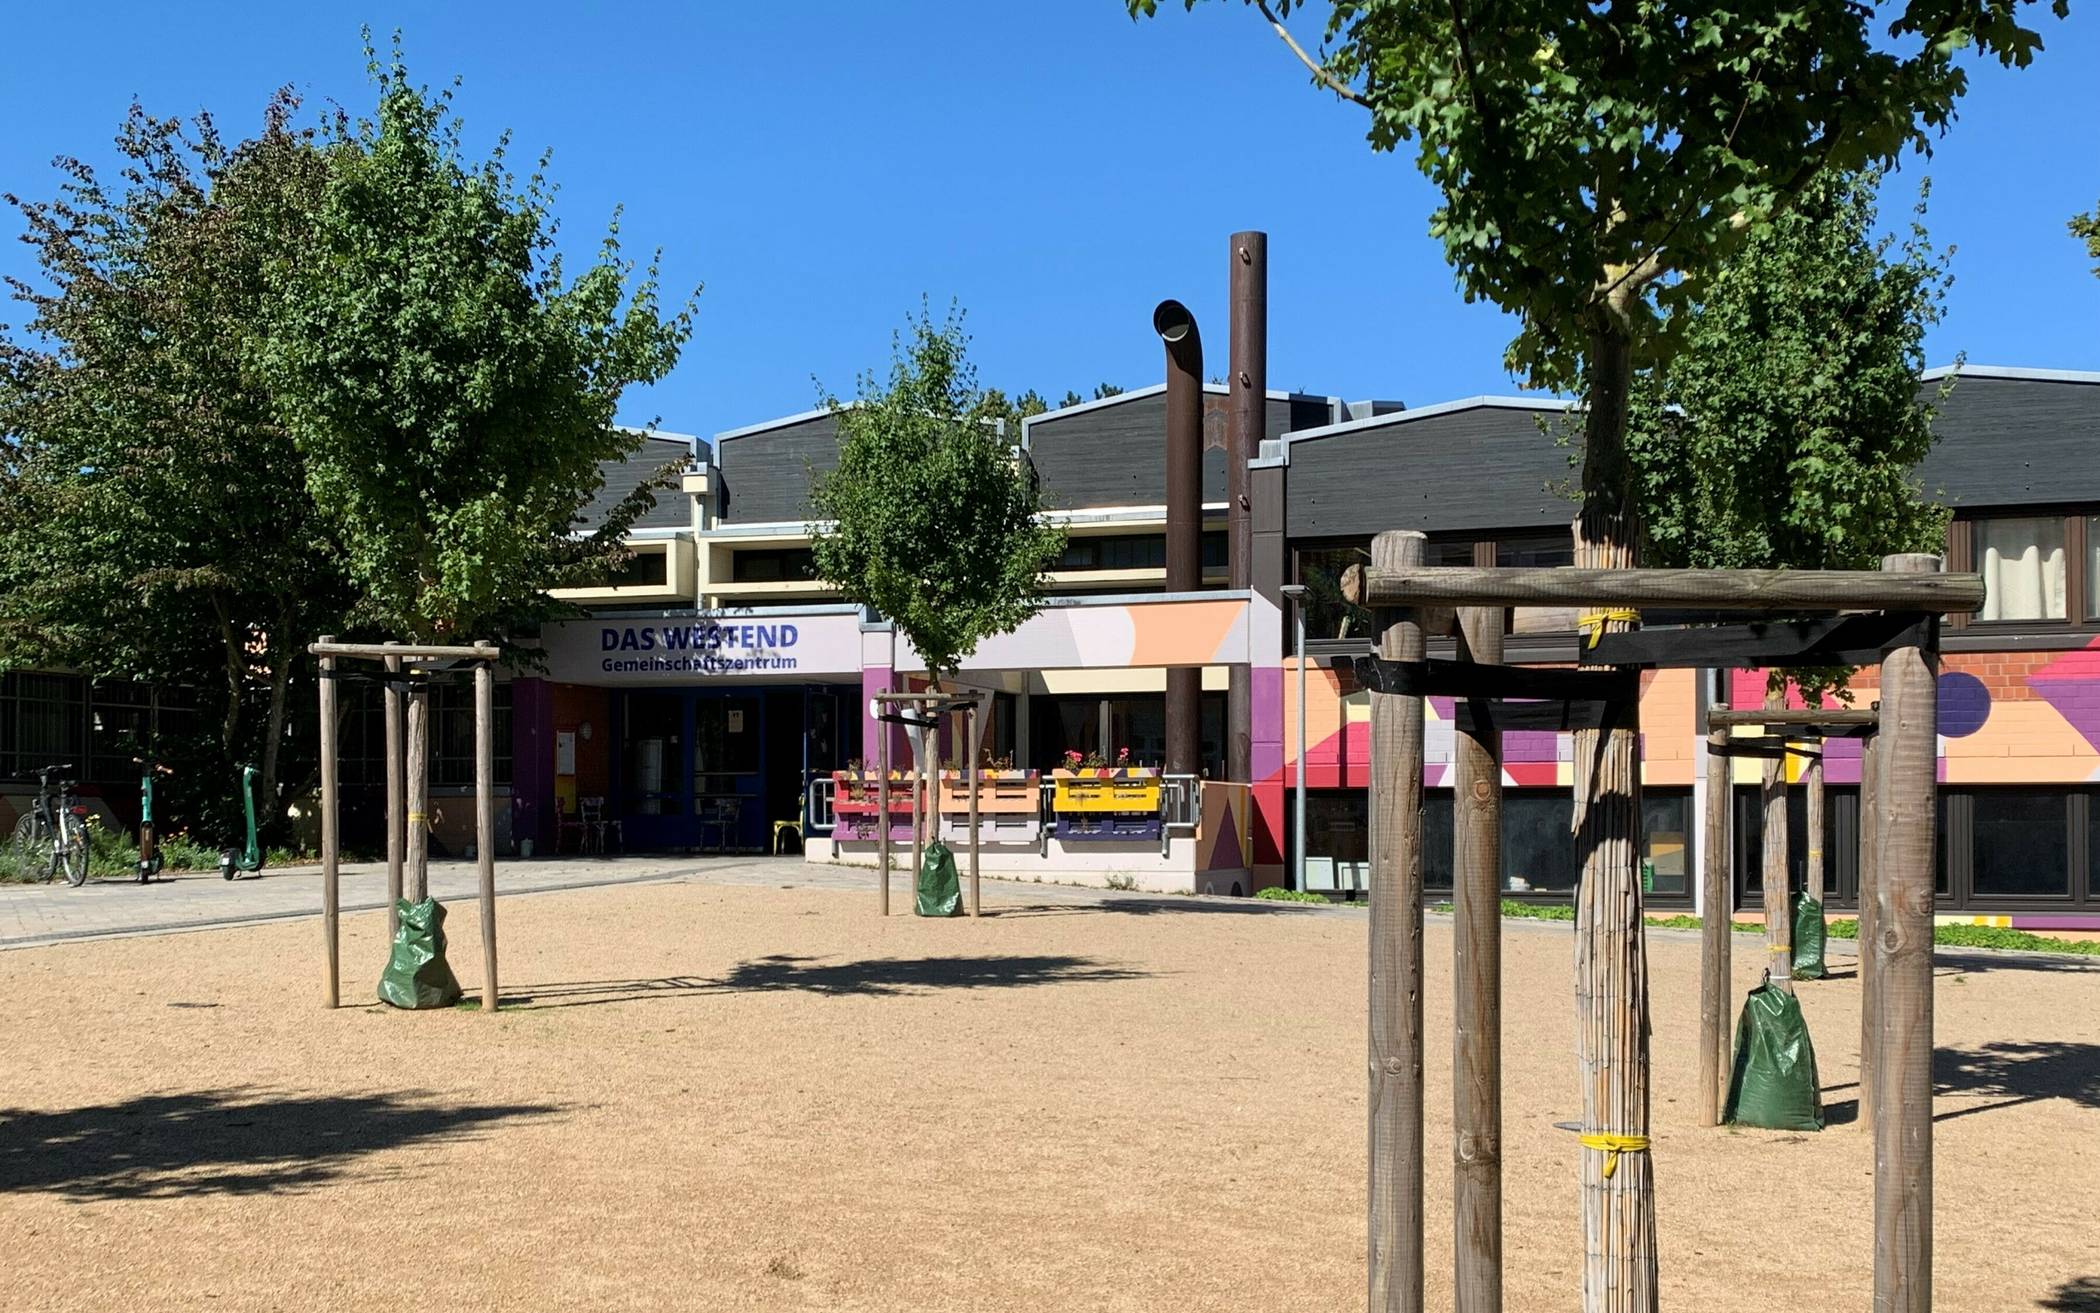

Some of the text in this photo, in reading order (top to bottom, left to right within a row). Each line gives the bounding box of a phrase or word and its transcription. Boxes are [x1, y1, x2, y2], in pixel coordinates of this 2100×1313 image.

[601, 624, 798, 651] DAS WESTEND
[602, 655, 797, 672] Gemeinschaftszentrum
